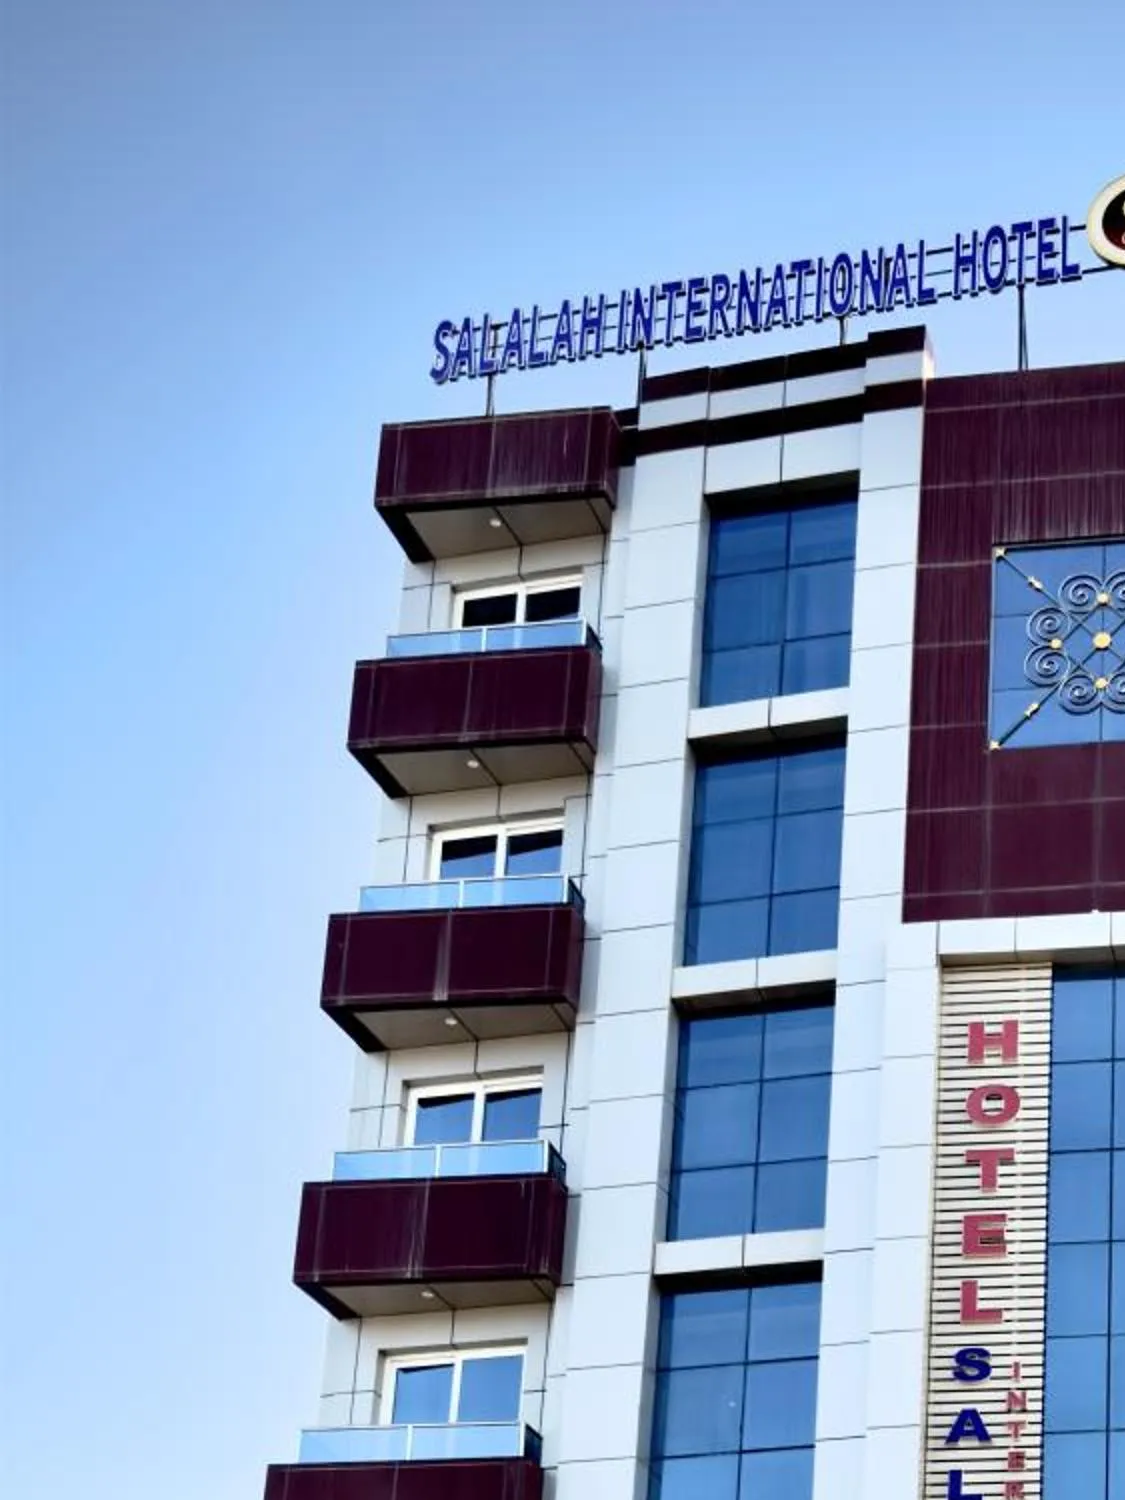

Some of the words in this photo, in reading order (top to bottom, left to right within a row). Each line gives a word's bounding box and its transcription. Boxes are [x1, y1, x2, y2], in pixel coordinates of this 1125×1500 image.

[429, 292, 606, 386] SALALAH
[616, 239, 938, 353] INTERNATIONAL
[952, 214, 1082, 299] HOTEL
[959, 1019, 1021, 1326] HOTEL
